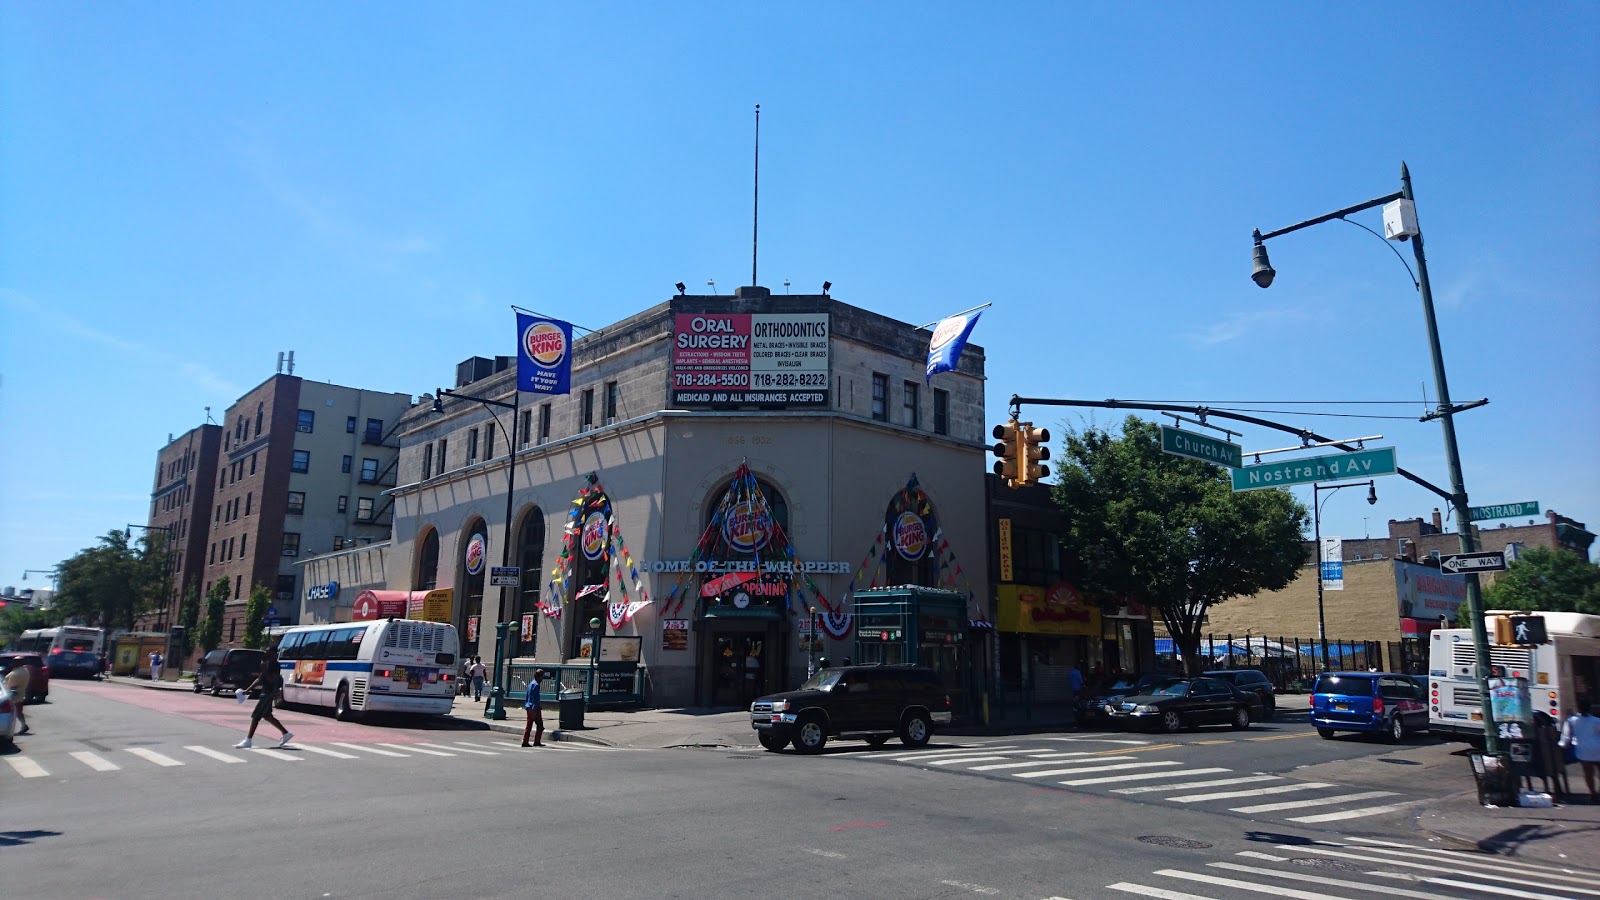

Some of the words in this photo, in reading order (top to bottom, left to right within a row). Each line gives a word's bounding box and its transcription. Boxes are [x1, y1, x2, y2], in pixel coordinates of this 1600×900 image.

[691, 317, 735, 333] ORAL
[754, 322, 826, 338] ORTHODONTICS
[530, 332, 561, 345] BURGER
[677, 333, 749, 349] SURGERY
[531, 340, 562, 356] KING
[536, 370, 556, 379] HAVE
[540, 377, 558, 385] YOUR
[676, 373, 748, 386] 718-284-5500
[754, 373, 826, 386] 718-282-8222
[677, 393, 710, 402] MEDICAID
[712, 393, 727, 402] AND
[730, 393, 742, 402] ALL
[745, 393, 787, 402] INSURANCES
[789, 393, 824, 402] ACCEPTED
[1175, 435, 1218, 458] Church
[1219, 449, 1233, 462] Av
[1249, 461, 1339, 484] Nostrand
[1346, 458, 1372, 473] Av
[1472, 503, 1523, 520] NOSTRAND
[900, 531, 924, 547] KING
[639, 560, 691, 572] HOME
[695, 560, 717, 572] OF
[725, 560, 757, 572] THE
[764, 560, 851, 573] WHOPPER
[1448, 560, 1468, 569] ONE
[1478, 557, 1499, 566] WAY
[307, 584, 329, 600] CHASE
[703, 573, 742, 596] Grand
[741, 581, 788, 597] OPENING
[1415, 574, 1450, 596] BARGAIN
[666, 621, 670, 629] 2
